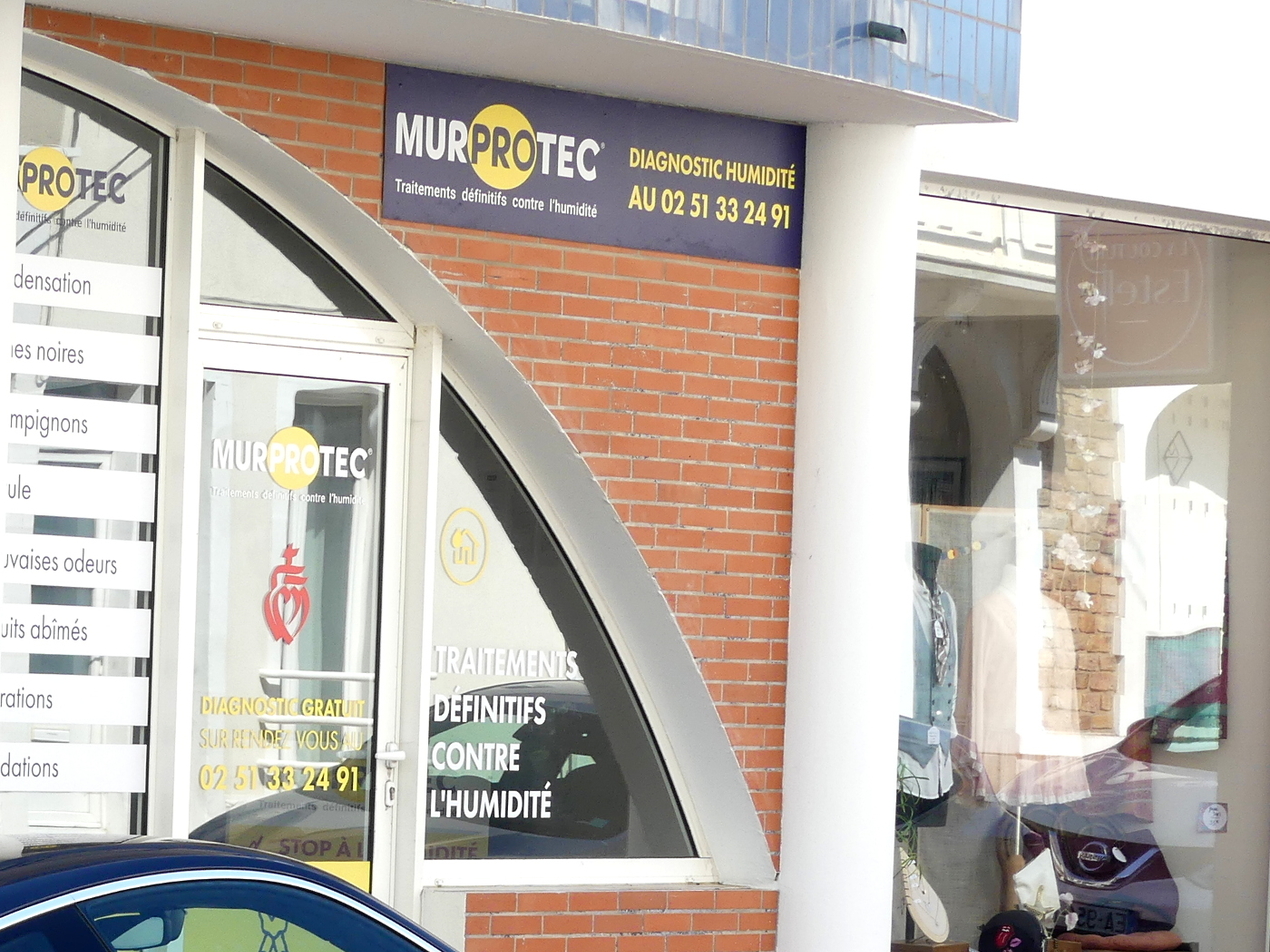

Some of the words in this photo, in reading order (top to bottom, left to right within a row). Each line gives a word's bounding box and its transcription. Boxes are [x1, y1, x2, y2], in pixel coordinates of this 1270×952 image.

[629, 147, 723, 180] DIAGNOSTIC
[726, 161, 796, 190] HUMIDITÉ
[395, 178, 456, 200] Traitements
[461, 187, 507, 207] définitifs
[512, 195, 545, 212] contre
[549, 198, 598, 218] l'humidité
[628, 185, 657, 212] AU
[661, 188, 685, 216] 02
[690, 193, 709, 219] 51
[715, 195, 739, 223] 33
[743, 199, 767, 226] 24
[771, 203, 790, 230] 91
[86, 218, 127, 233] l'humidité
[14, 263, 91, 295] densation
[37, 341, 84, 365] noires
[10, 408, 88, 439] mpignons
[301, 493, 326, 504] contre
[64, 548, 118, 575] odeurs
[30, 614, 88, 641] abîmés
[435, 645, 578, 680] TRAITEMENTS
[0, 687, 53, 709] rations
[201, 696, 299, 716] DIAGNOSTIC
[301, 698, 366, 718] GRATUIT
[434, 685, 547, 726] DÉFINITIFS
[200, 729, 228, 749] SUR
[234, 730, 294, 750] RENDEZ
[296, 730, 339, 751] VOUS
[342, 731, 363, 751] AU
[432, 742, 520, 771] CONTRE
[200, 764, 228, 791] 02
[234, 765, 258, 791] 51
[267, 765, 296, 791] 33
[302, 766, 330, 791] 24
[336, 765, 359, 792] 91
[430, 781, 552, 819] L'HUMIDITÉ
[280, 838, 332, 858] STOP
[336, 836, 351, 858] À
